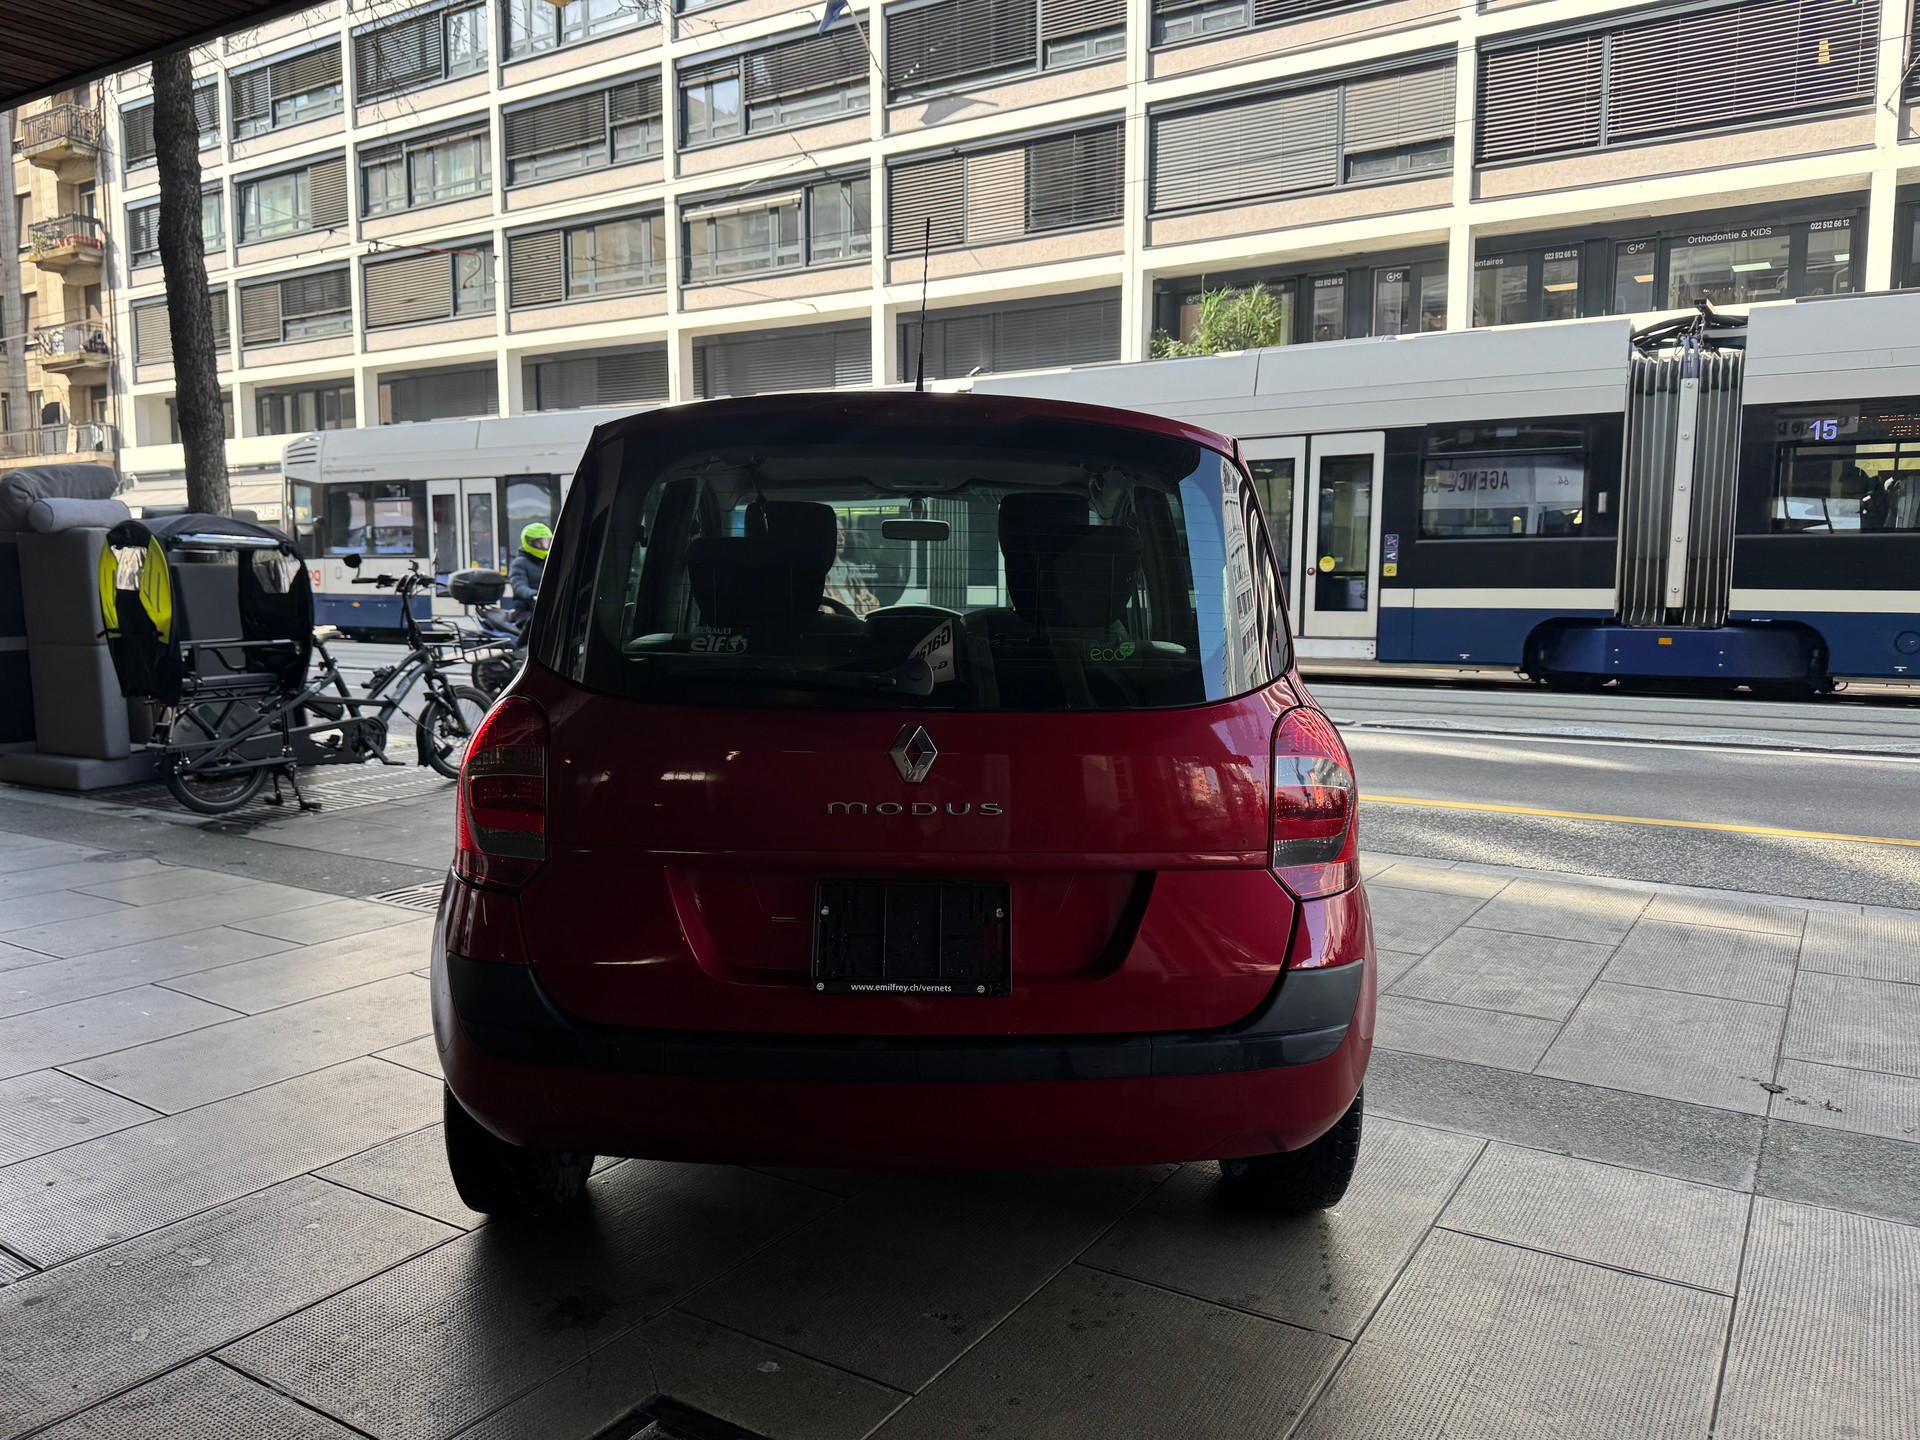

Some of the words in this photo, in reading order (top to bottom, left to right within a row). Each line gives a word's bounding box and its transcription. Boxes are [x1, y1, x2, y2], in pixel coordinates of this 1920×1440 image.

[1810, 222, 1822, 230] 022
[1823, 221, 1833, 229] 512
[1834, 220, 1842, 228] 66
[1843, 219, 1850, 227] 12
[1688, 231, 1739, 244] Orthodontie
[1741, 229, 1748, 238] &
[1750, 227, 1772, 237] KIDS
[1544, 252, 1554, 260] 022
[1555, 251, 1564, 259] 512
[1809, 419, 1838, 440] 15
[690, 634, 727, 652] elf
[827, 801, 1003, 816] MODUS
[851, 982, 952, 993] www.emilfrey.ch/vernets
